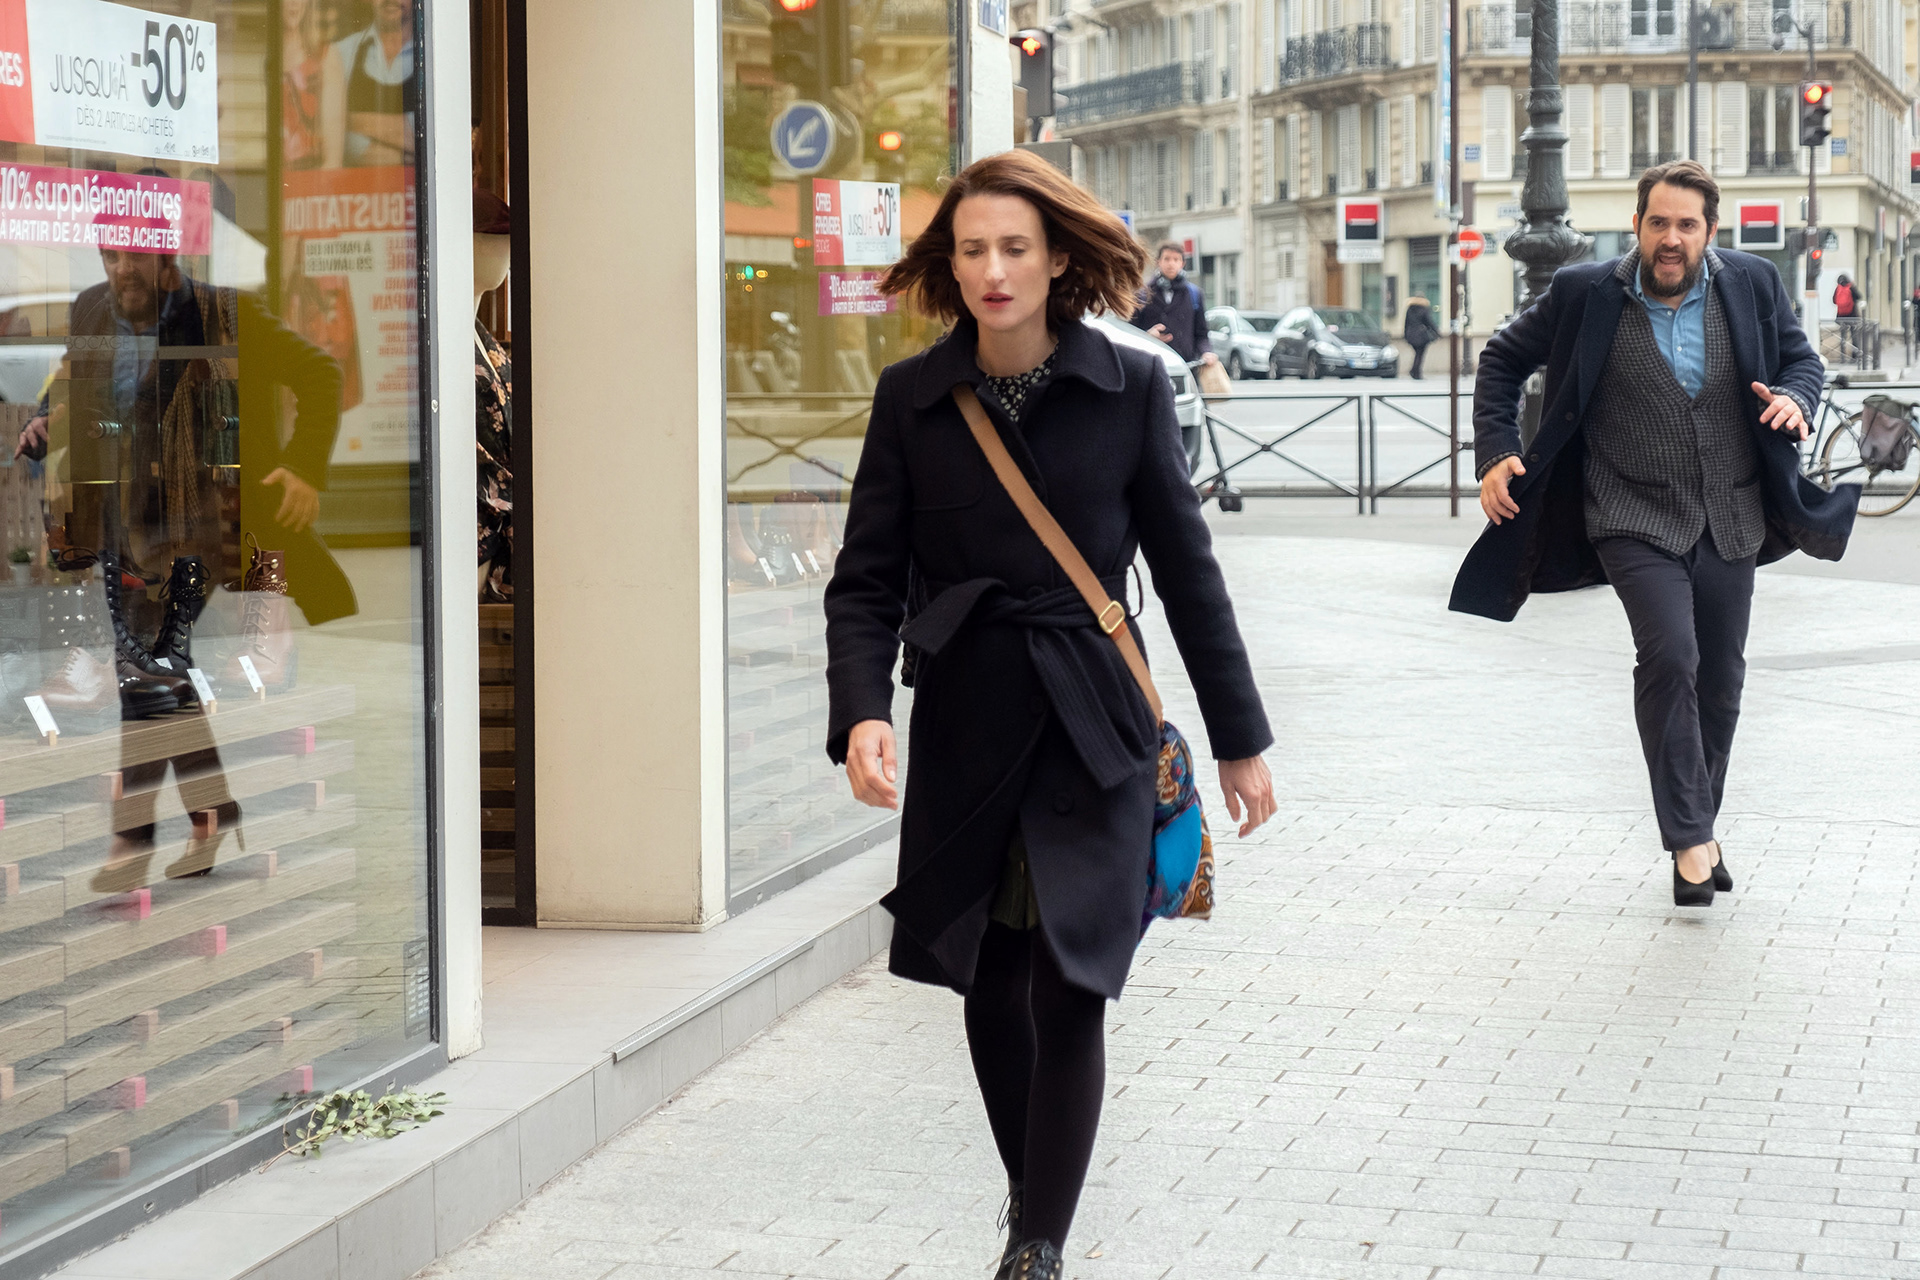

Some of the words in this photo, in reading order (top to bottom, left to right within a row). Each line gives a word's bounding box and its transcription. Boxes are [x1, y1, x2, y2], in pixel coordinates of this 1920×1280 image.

[50, 54, 128, 101] JUSQU'À
[131, 20, 205, 111] -50%
[97, 109, 103, 127] 2
[35, 174, 182, 221] supplémentaires
[9, 219, 49, 241] PARTIR
[53, 221, 70, 243] DE
[73, 222, 81, 244] 2
[83, 223, 131, 247] ARTICLES
[64, 335, 130, 350] BOCAGE
